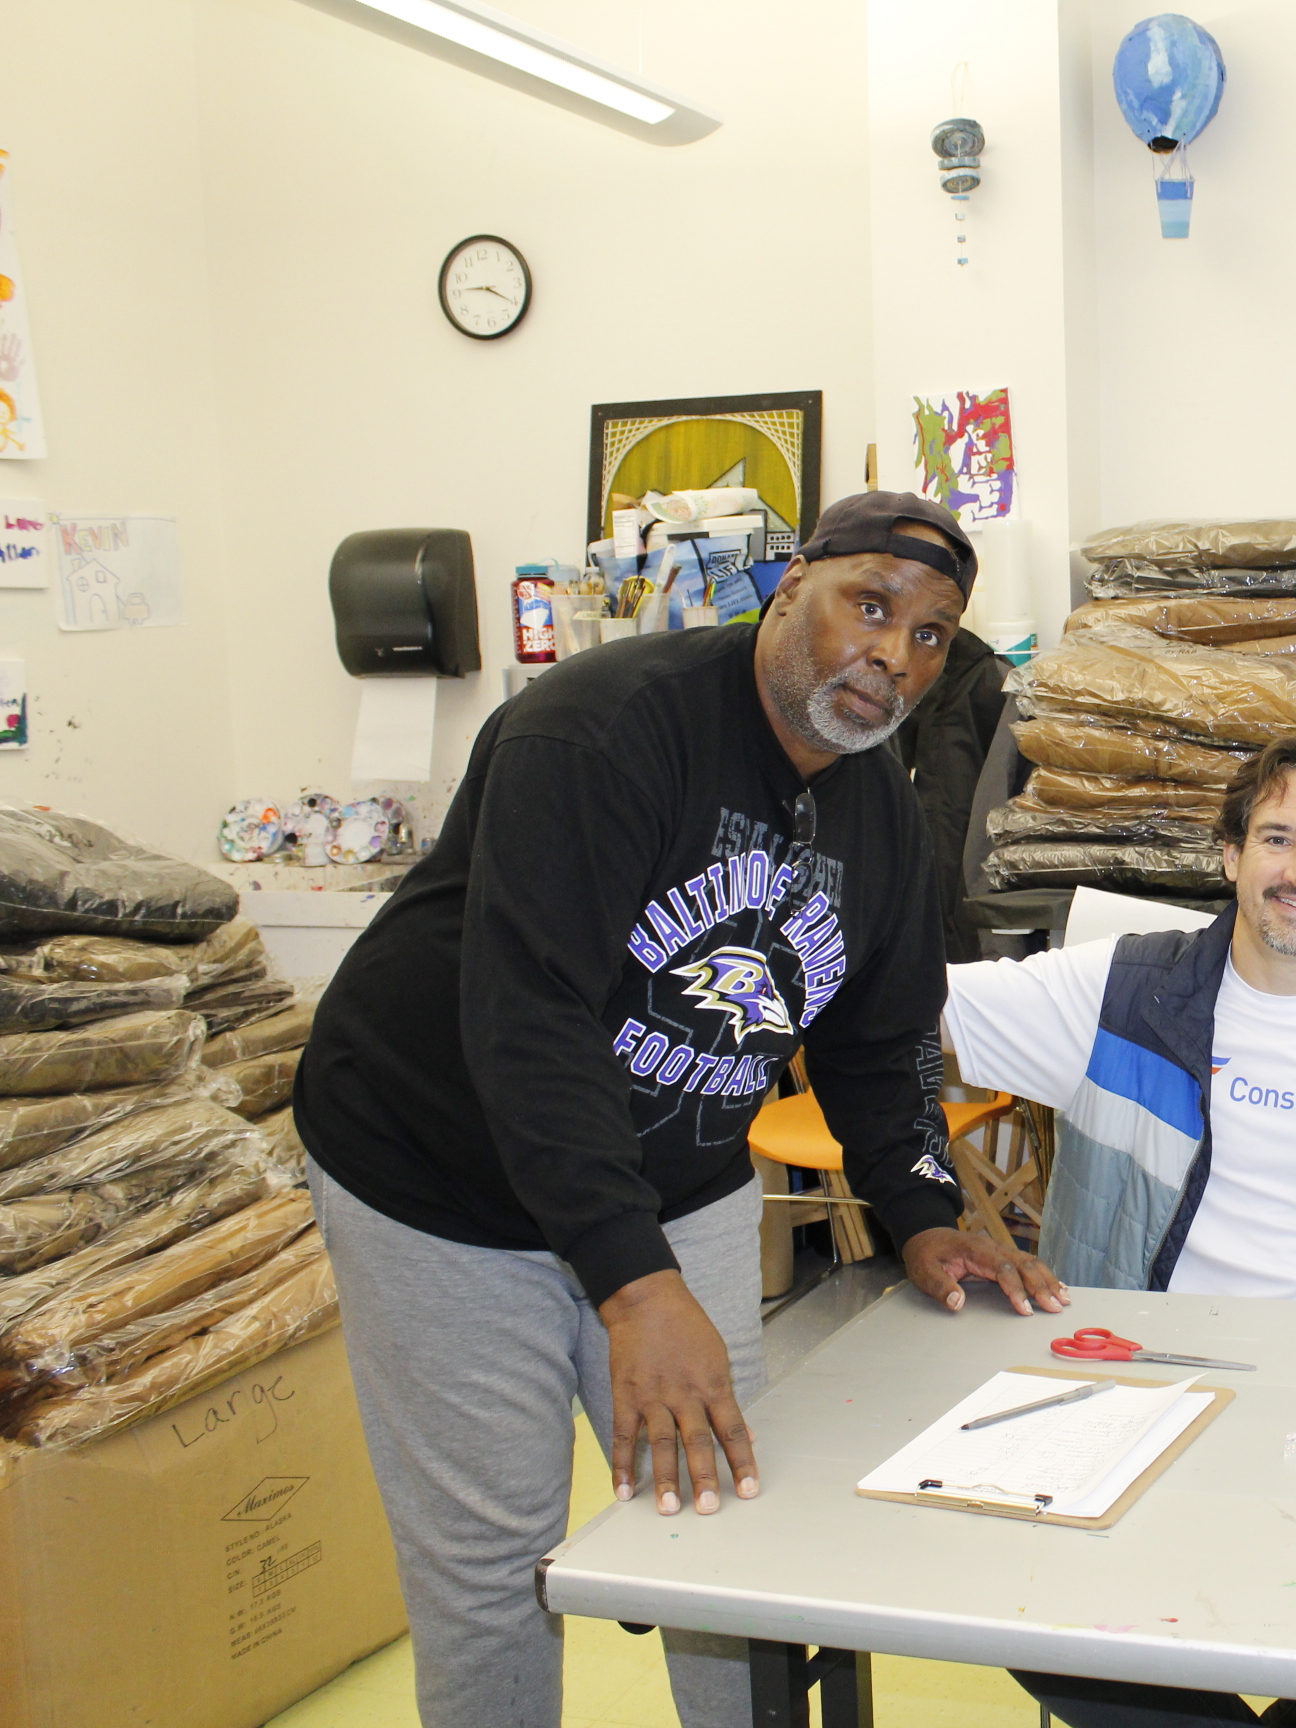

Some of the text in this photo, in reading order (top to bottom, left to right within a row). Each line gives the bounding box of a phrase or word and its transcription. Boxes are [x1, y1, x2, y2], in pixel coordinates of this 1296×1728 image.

[60, 521, 130, 556] KEVIN
[523, 628, 555, 640] HIGH
[524, 640, 556, 652] ZERO
[779, 890, 849, 1028] RAVENS
[613, 1017, 778, 1097] FOOTBALL
[171, 1375, 295, 1449] Large
[237, 1483, 295, 1518] Maximos
[225, 1535, 247, 1553] STYLE
[265, 1512, 291, 1531] ALASKA
[256, 1533, 280, 1552] CAMEL
[231, 1644, 251, 1660] MADE
[261, 1627, 281, 1644] CHINA
